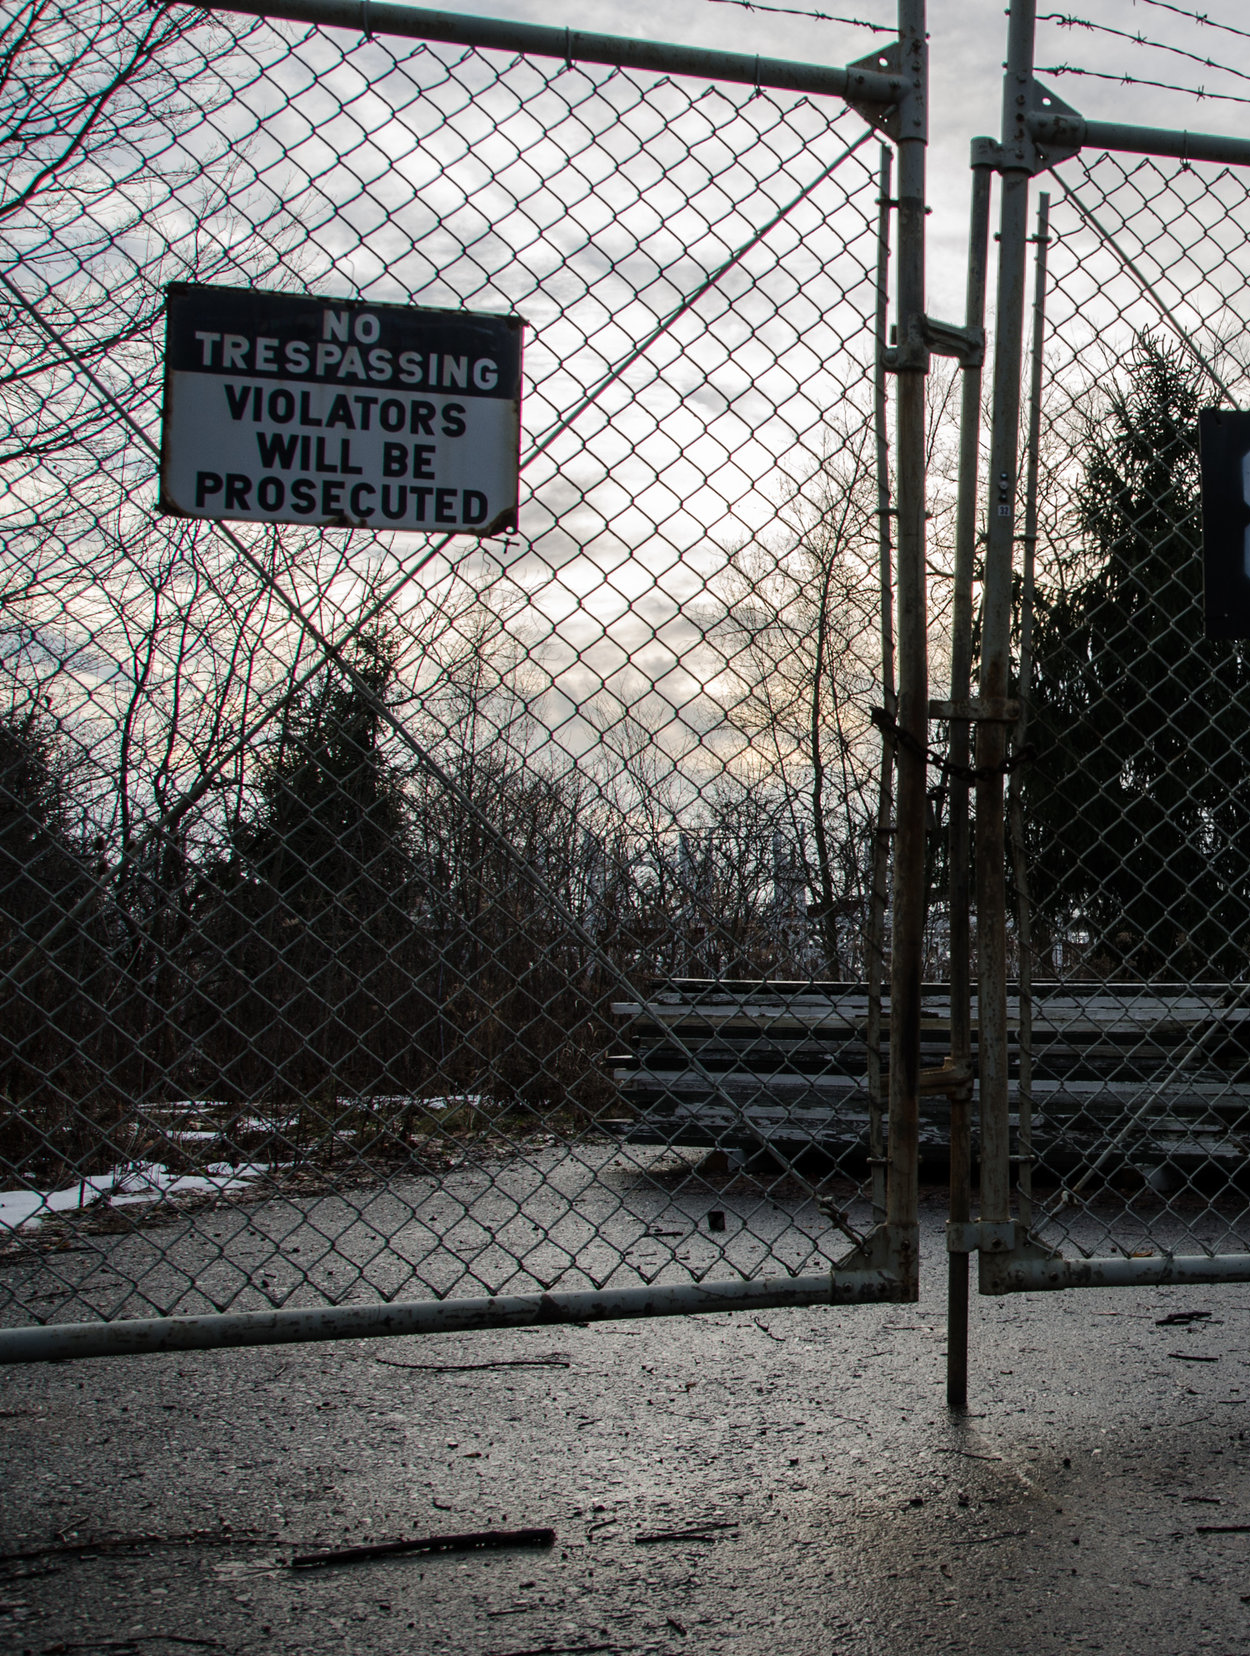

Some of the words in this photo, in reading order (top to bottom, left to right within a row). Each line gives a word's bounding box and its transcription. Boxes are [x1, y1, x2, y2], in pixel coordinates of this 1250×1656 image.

[323, 309, 381, 344] NO
[195, 331, 499, 391] TRESPASSING
[224, 384, 467, 438] VIOLATORS
[256, 431, 363, 476] WILL
[383, 441, 436, 480] BE
[195, 470, 488, 525] PROSECUTED
